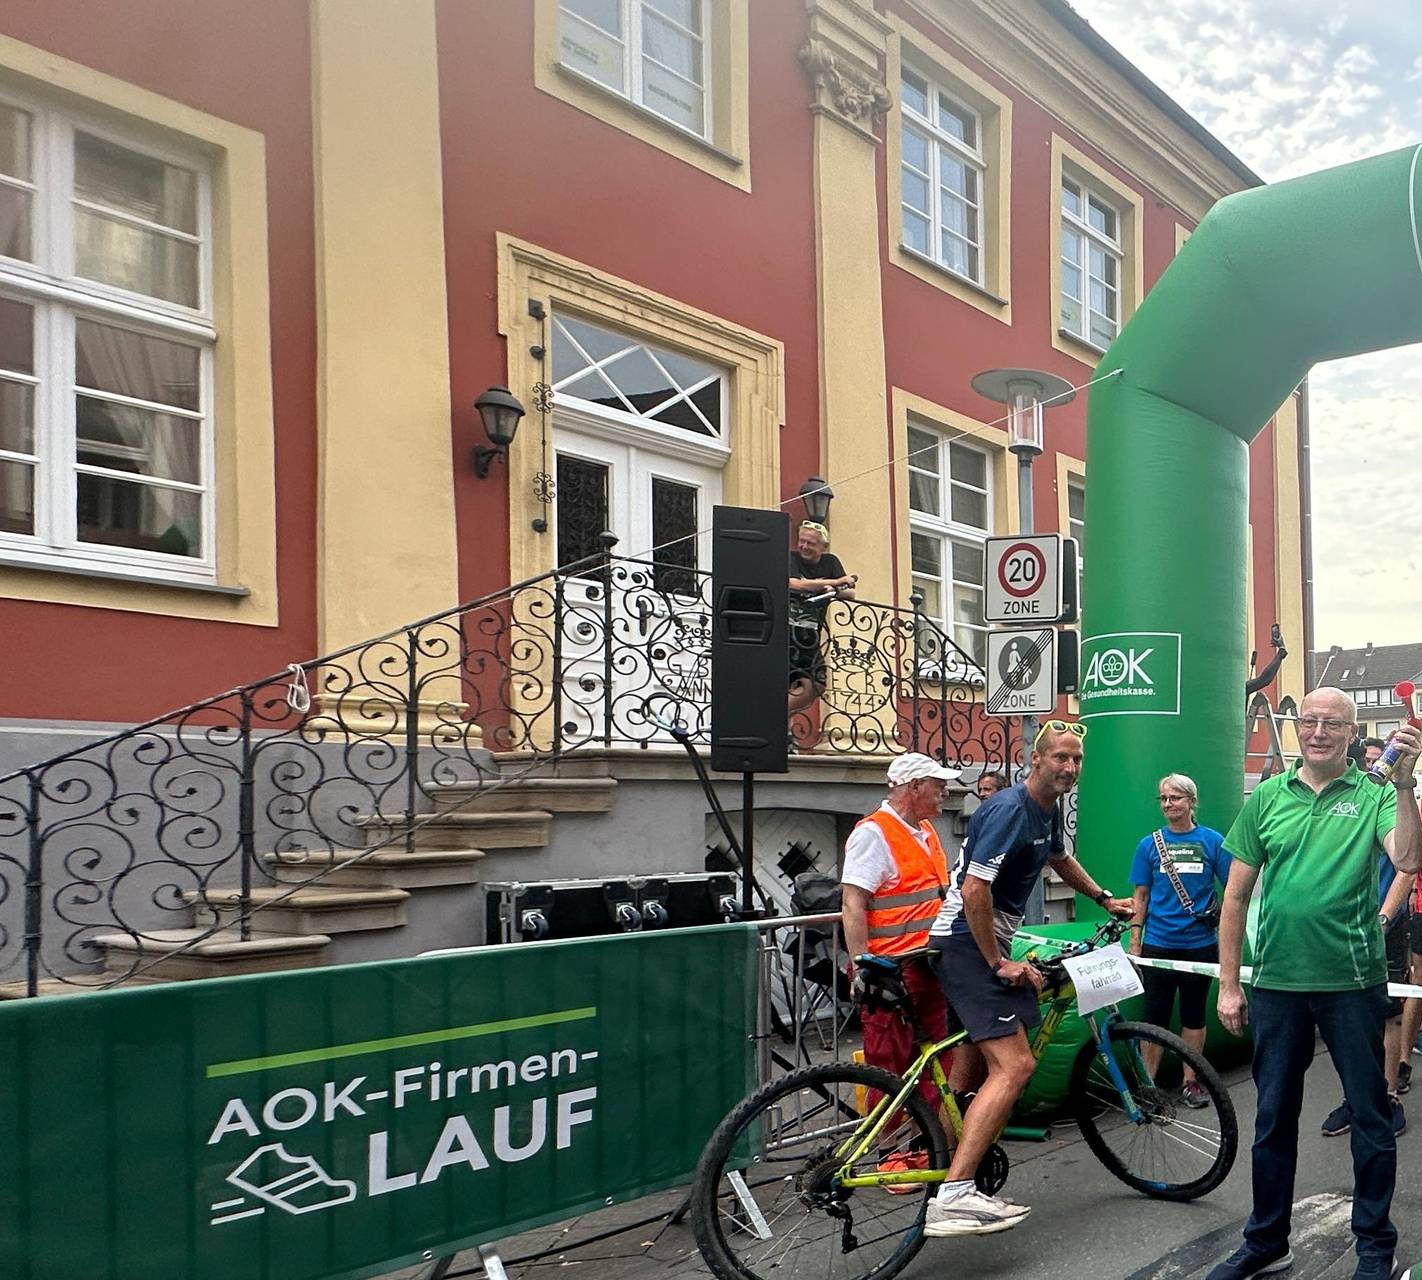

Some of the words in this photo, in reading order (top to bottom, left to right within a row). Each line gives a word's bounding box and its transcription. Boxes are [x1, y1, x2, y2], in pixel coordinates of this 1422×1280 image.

[1008, 557, 1036, 583] 20
[1003, 600, 1040, 615] ZONE
[1082, 648, 1154, 690] AOK
[1003, 694, 1036, 708] ZONE
[1327, 801, 1360, 815] AOK
[207, 1048, 599, 1145] AOK-Firmen-
[369, 1086, 598, 1197] LAUF
